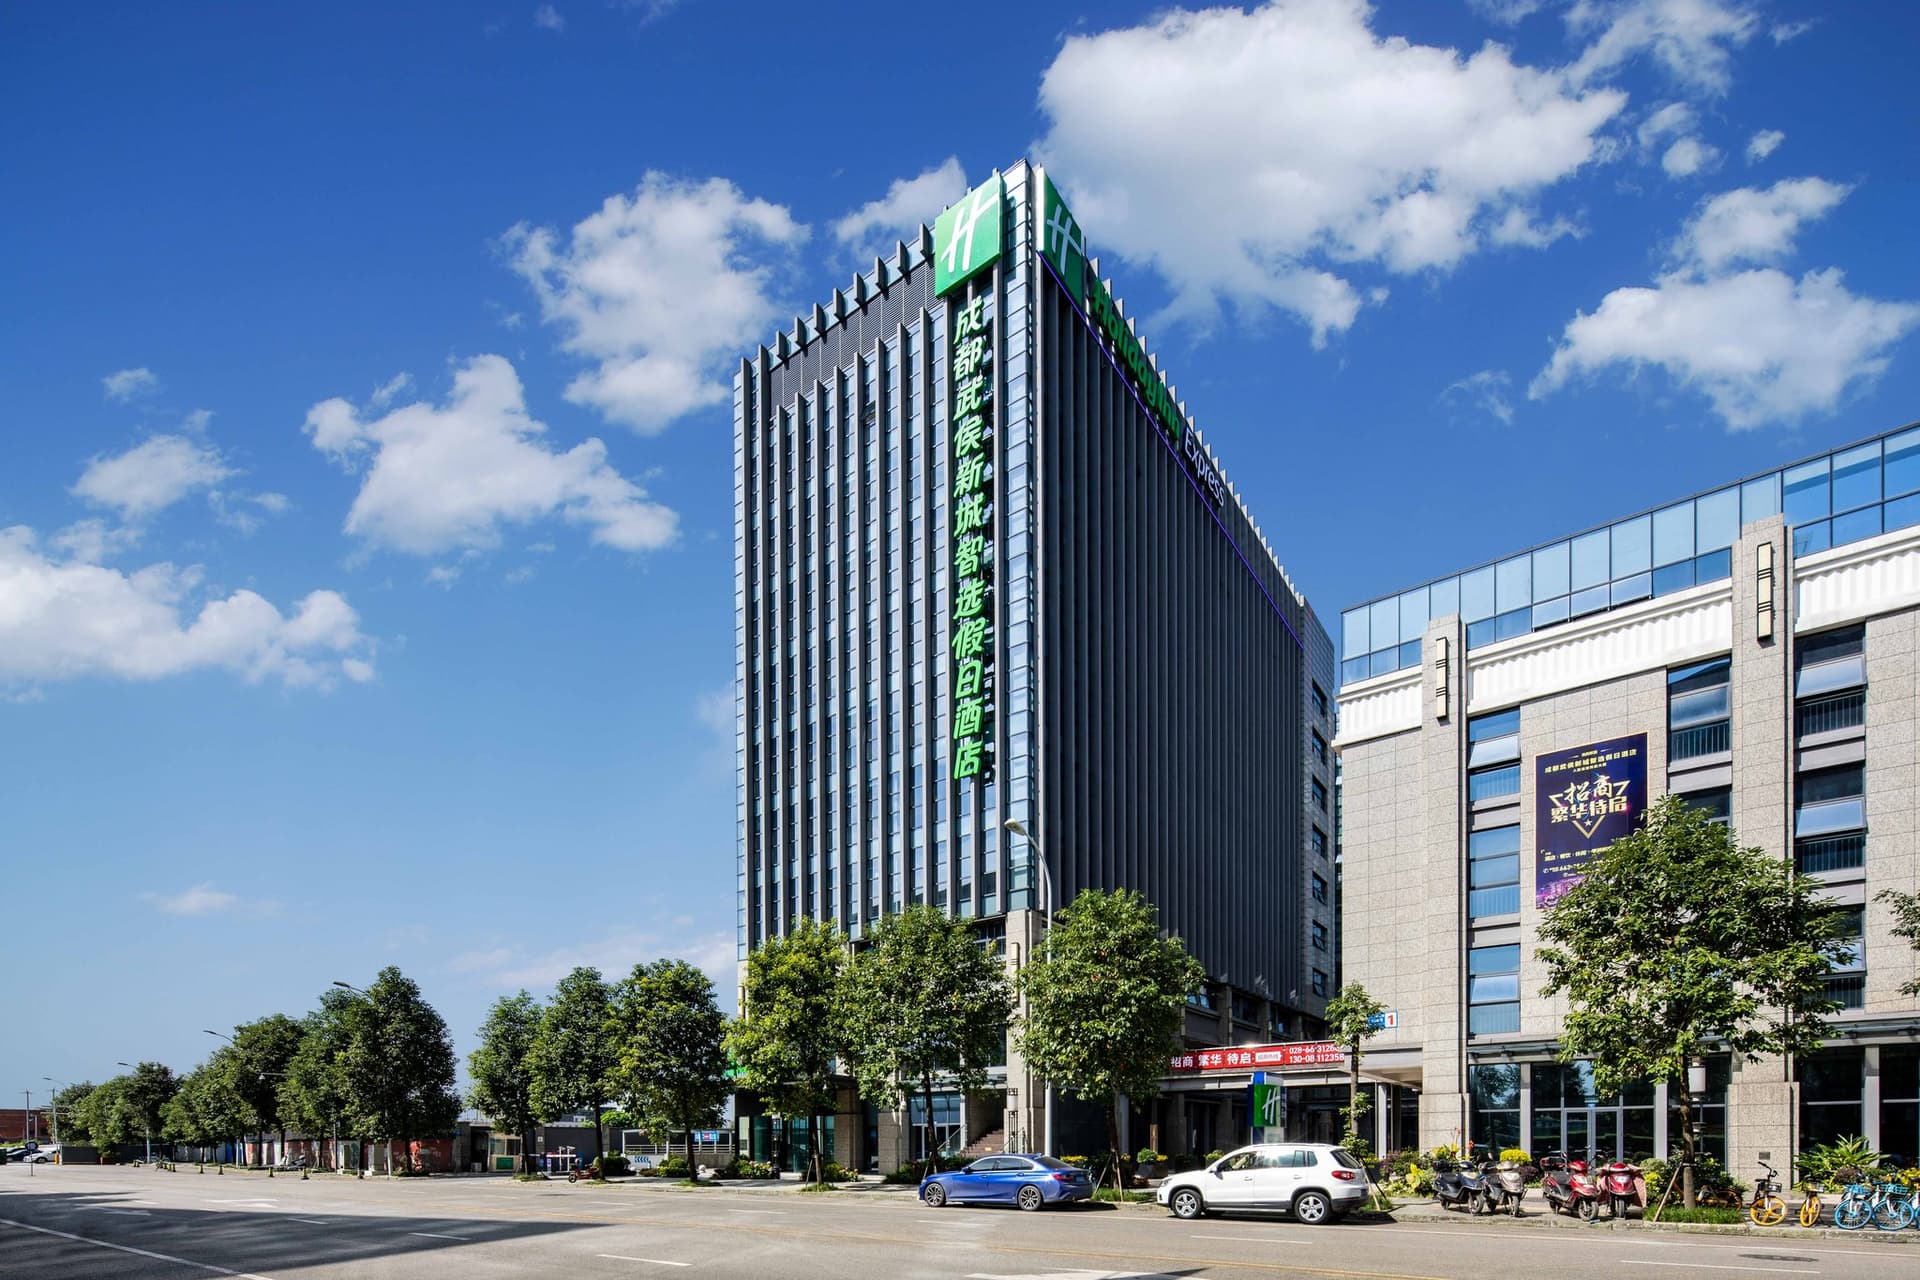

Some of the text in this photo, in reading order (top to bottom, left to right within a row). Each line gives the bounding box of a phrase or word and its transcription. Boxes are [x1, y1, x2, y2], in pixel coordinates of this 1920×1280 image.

[1092, 279, 1225, 507] Holiday Inn Express
[952, 296, 986, 779] 成都武侯新城智选假日酒店
[1564, 775, 1612, 804] 招商
[1170, 1056, 1193, 1068] 招商
